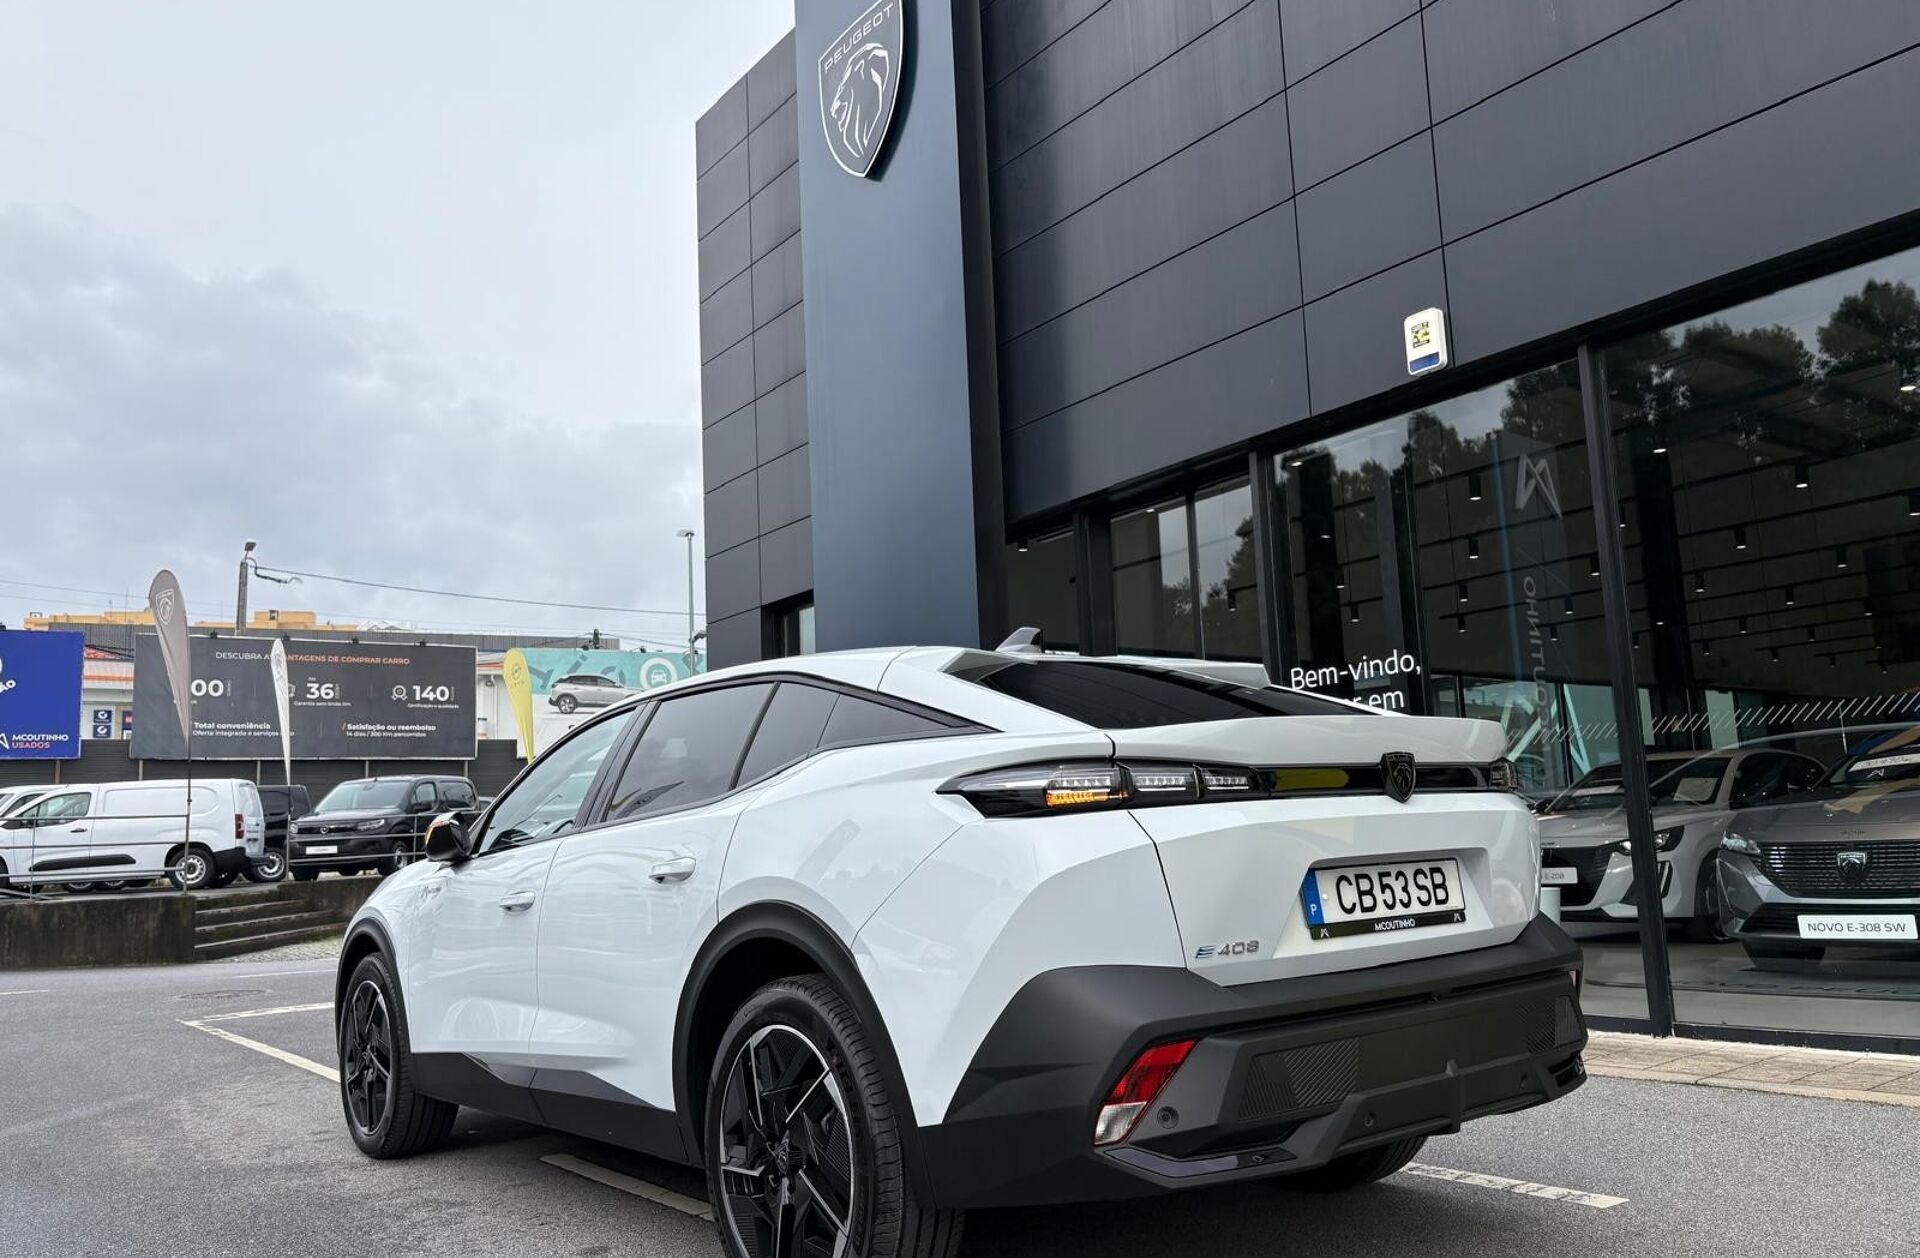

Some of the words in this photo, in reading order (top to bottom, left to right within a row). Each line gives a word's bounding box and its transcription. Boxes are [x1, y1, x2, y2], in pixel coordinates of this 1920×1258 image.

[824, 3, 893, 74] PEUGEOT
[215, 652, 262, 660] DESCUBRA
[287, 654, 326, 662] NTAGENS
[1290, 649, 1421, 690] Bem-vindo,
[306, 683, 334, 699] 36
[412, 685, 450, 701] 140
[1368, 690, 1405, 709] em
[215, 729, 247, 737] integrada
[347, 723, 386, 731] Satisfação
[398, 723, 436, 731] reembolso
[12, 741, 50, 749] USADOS
[1335, 873, 1377, 914] CB
[1378, 870, 1412, 910] 53
[1413, 867, 1449, 906] SB
[1311, 904, 1317, 916] P
[1374, 918, 1416, 931] MCOUTINHO
[1808, 923, 1844, 932] NOVO
[1847, 923, 1882, 932] E-308
[1884, 923, 1906, 932] SW
[1218, 940, 1259, 956] 408
